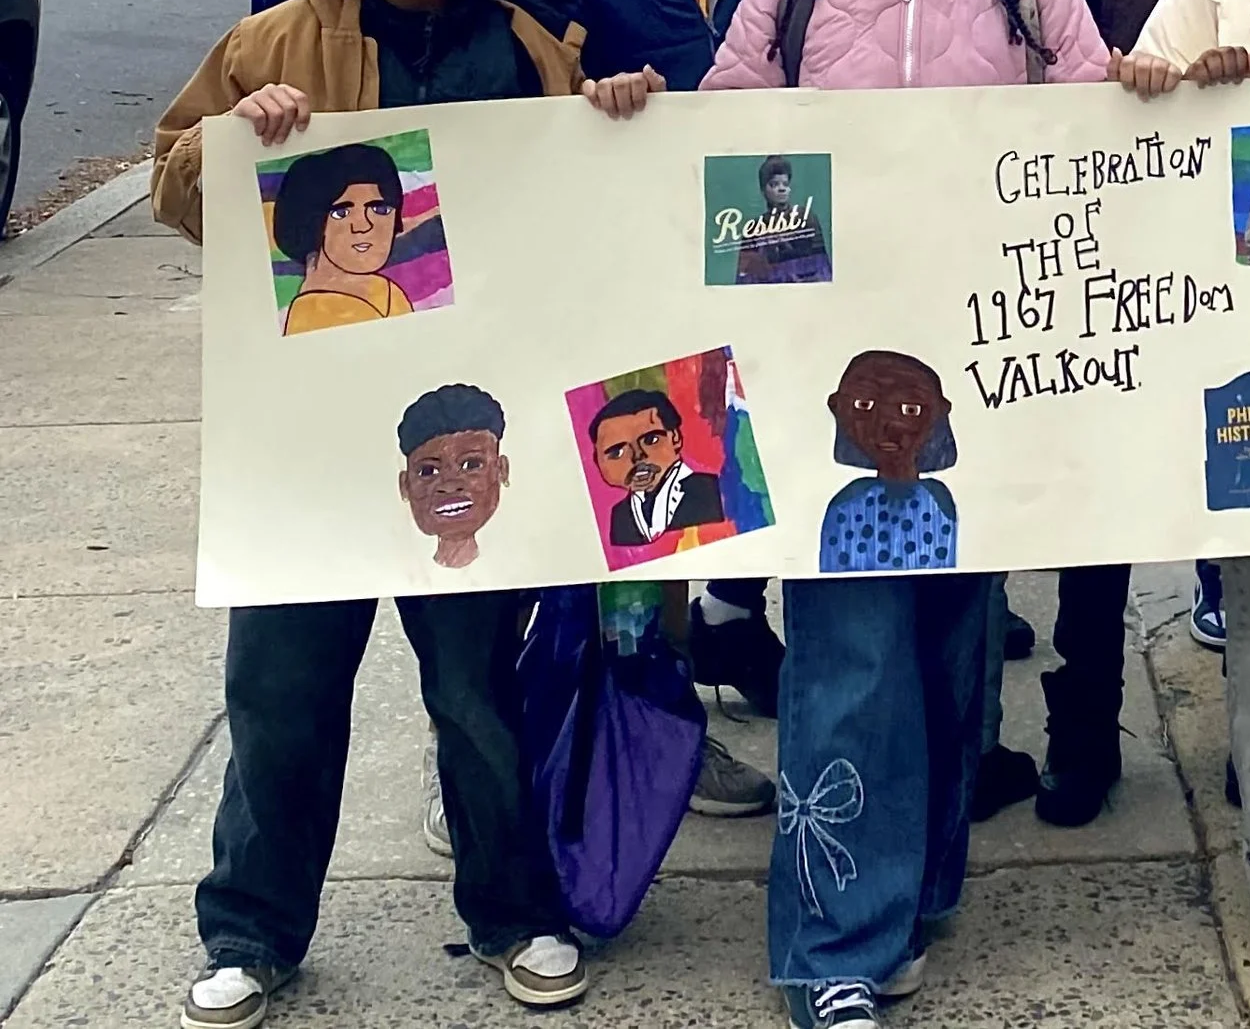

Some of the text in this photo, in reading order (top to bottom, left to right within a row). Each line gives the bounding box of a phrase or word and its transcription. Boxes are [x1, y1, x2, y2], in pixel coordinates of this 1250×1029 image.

[995, 131, 1211, 204] CELEBRATION
[712, 196, 813, 244] Resist!
[1002, 238, 1100, 290] THE
[967, 287, 1055, 345] 1967
